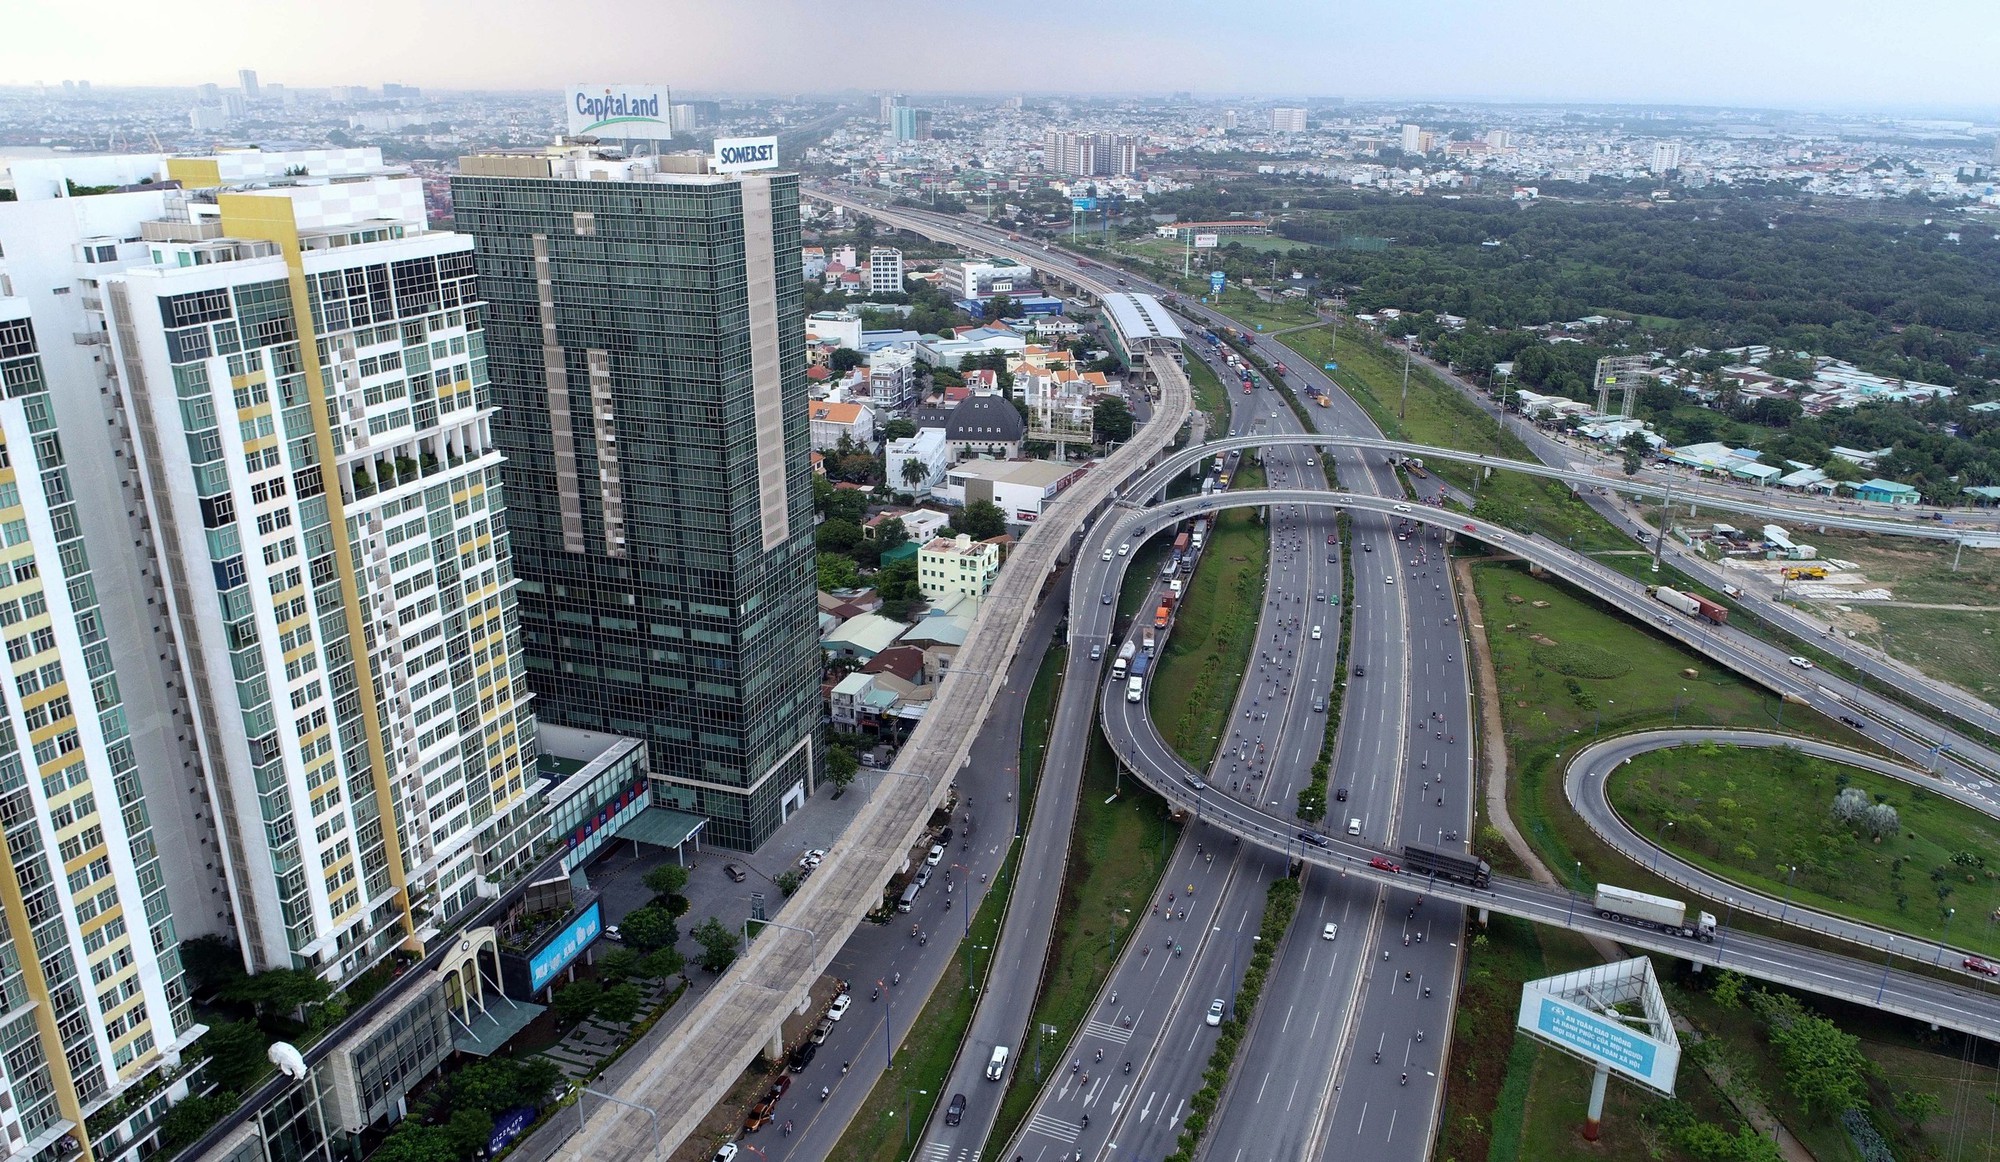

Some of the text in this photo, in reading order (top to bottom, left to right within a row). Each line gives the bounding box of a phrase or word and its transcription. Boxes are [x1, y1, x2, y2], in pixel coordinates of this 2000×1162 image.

[576, 88, 659, 121] CapitaLand
[721, 144, 774, 164] SOMERSET
[1552, 1017, 1560, 1026] LÀ
[1596, 1035, 1609, 1046] CỦA
[1565, 1015, 1632, 1048] AN TOÀN GIAO THÔNG
[1565, 1031, 1576, 1040] GIA
[1592, 1042, 1601, 1051] VÀ
[1602, 1046, 1619, 1059] TOÀN
[492, 1126, 511, 1145] PIZZA
